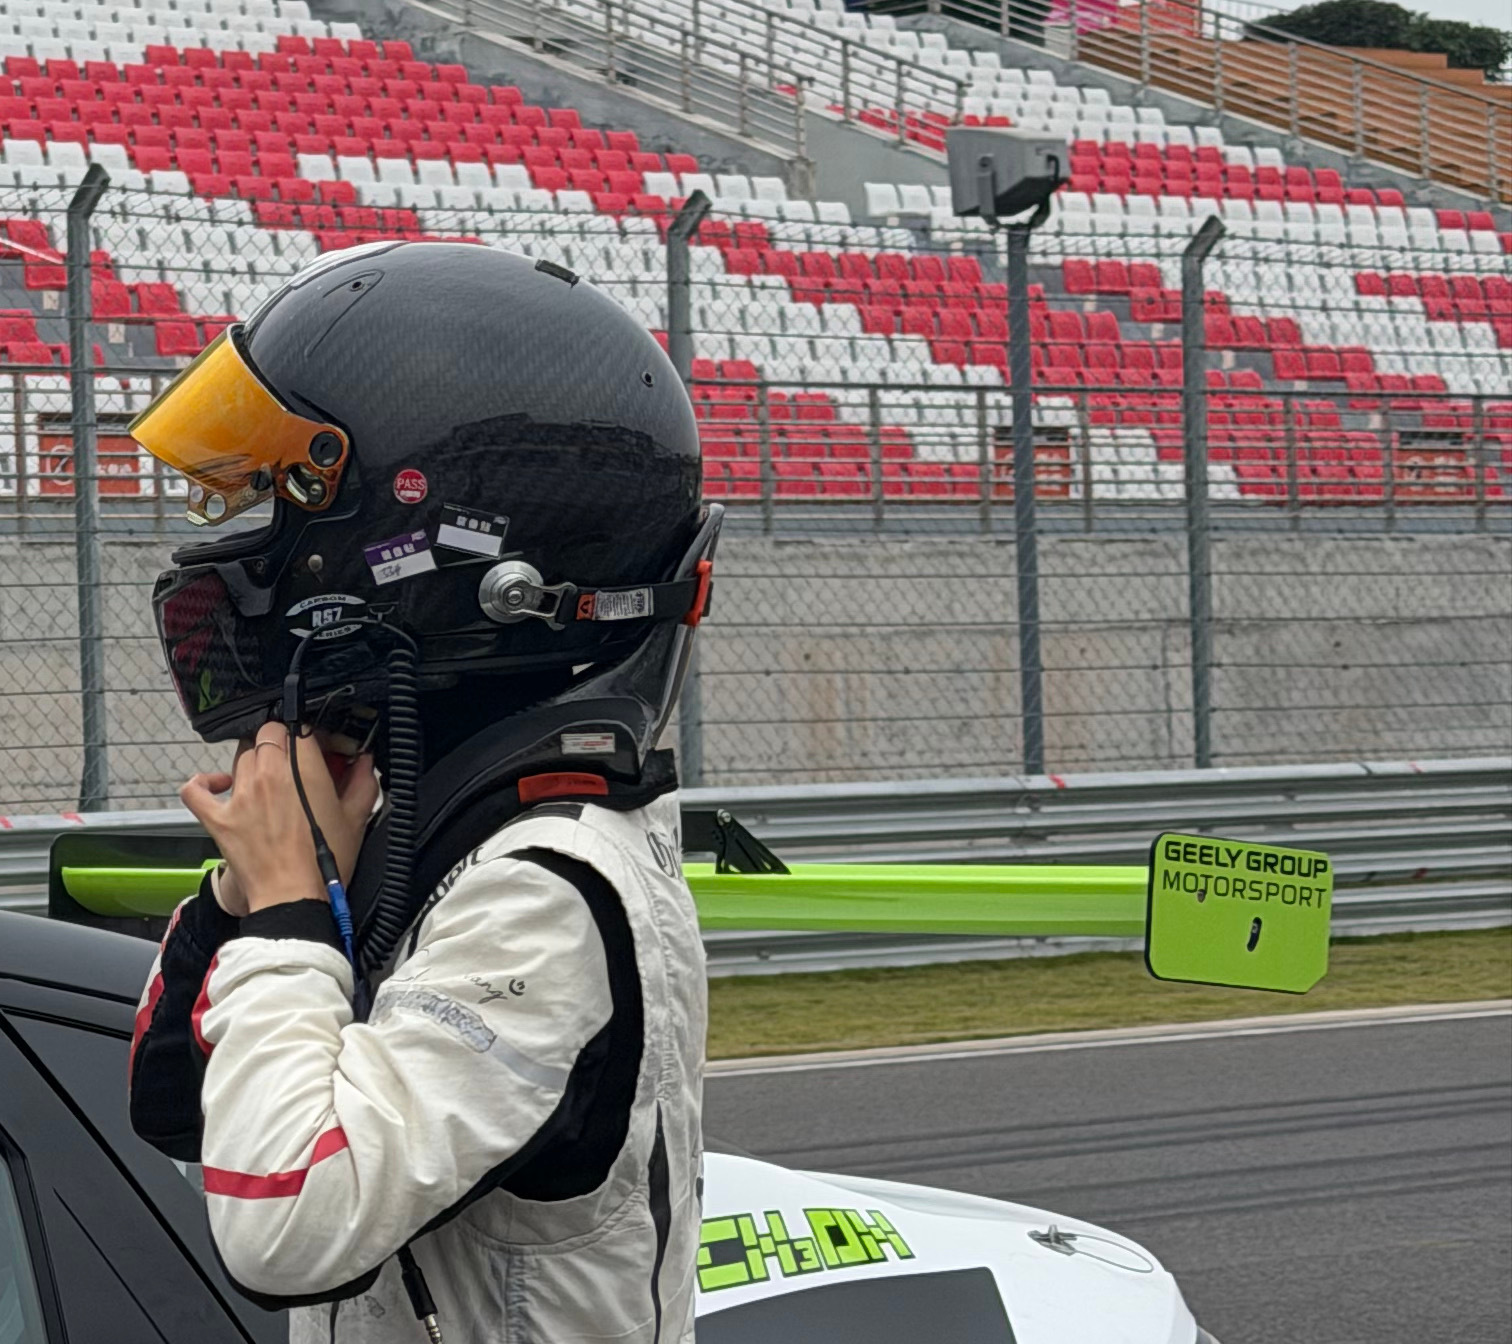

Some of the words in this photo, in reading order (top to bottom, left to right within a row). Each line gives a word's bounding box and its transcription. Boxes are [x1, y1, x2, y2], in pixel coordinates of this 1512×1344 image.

[396, 477, 426, 491] PASS
[1163, 840, 1243, 869] GEELY
[1245, 849, 1328, 879] GROUP
[1162, 868, 1328, 909] MOTORSPORT
